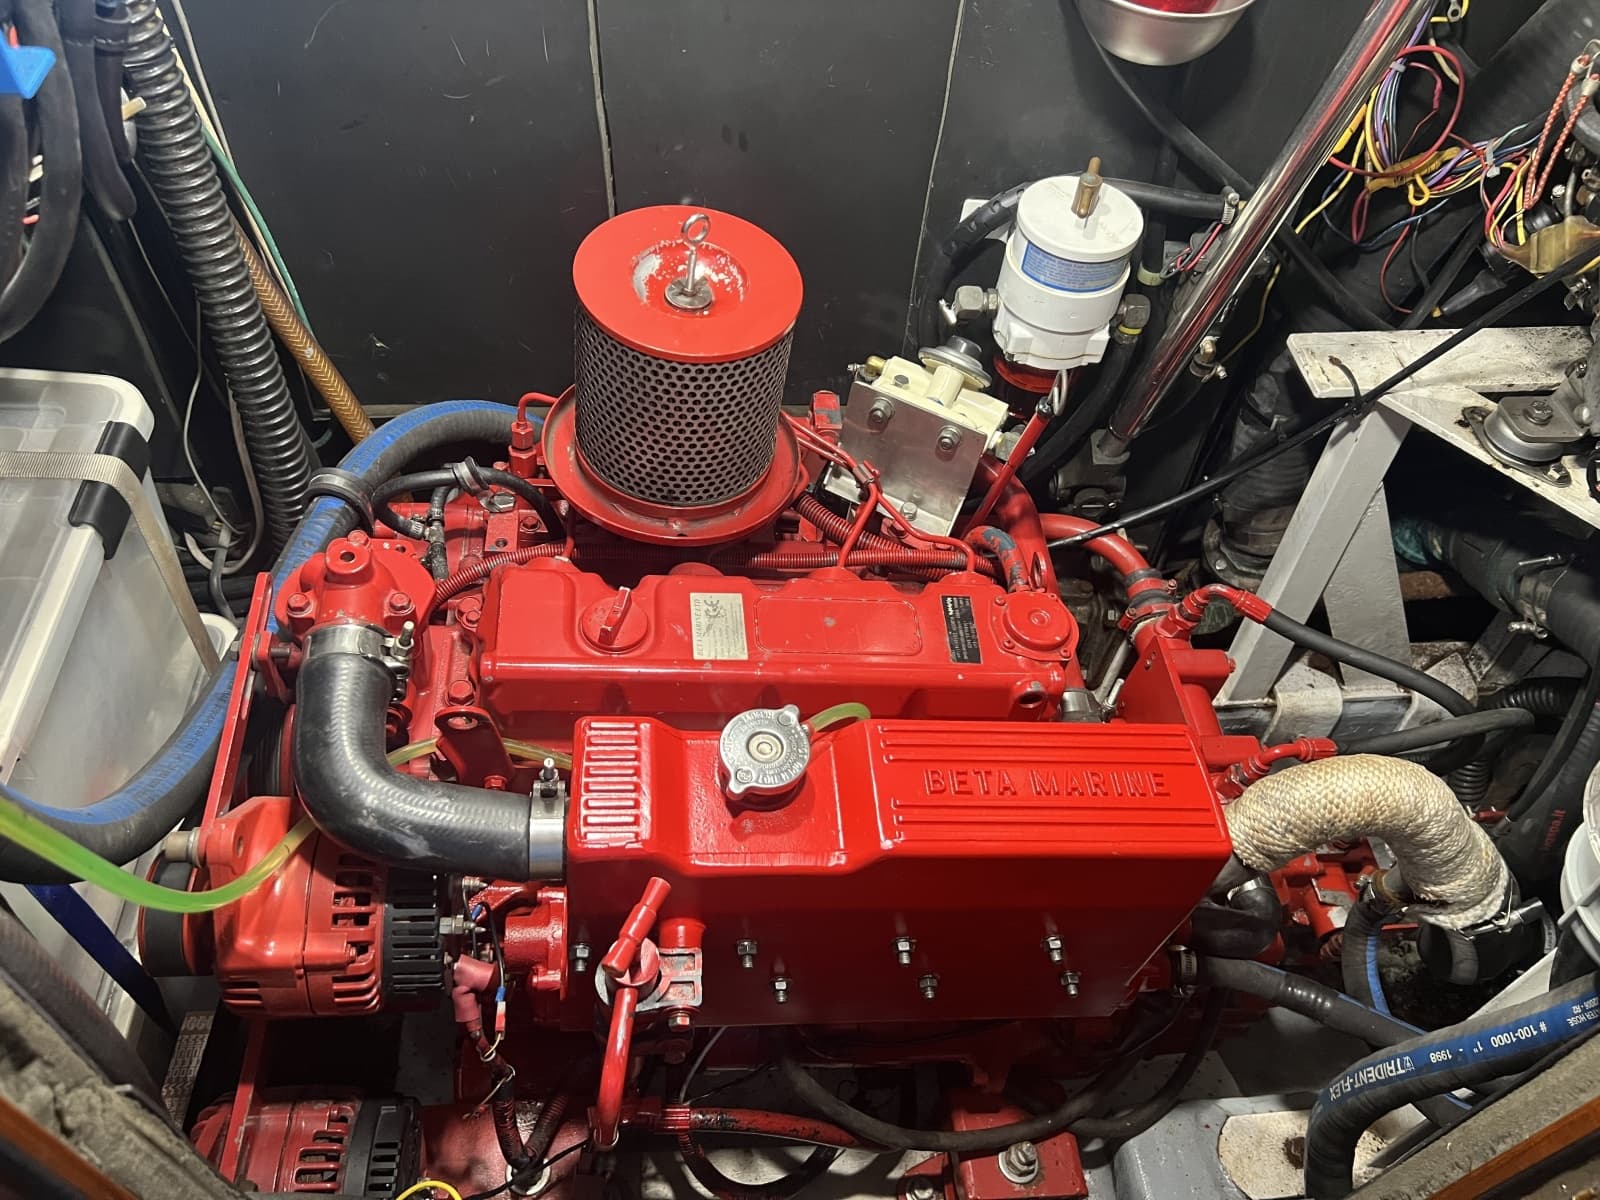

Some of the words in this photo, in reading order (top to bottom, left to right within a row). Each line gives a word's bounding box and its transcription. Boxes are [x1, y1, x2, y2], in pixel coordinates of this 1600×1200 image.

[922, 767, 1018, 796] BETA
[1029, 768, 1172, 798] MARINE
[1538, 1021, 1548, 1033] #
[1566, 1013, 1587, 1027] HOSE
[1490, 1024, 1538, 1048] 100-1000
[1429, 1048, 1453, 1063] 1998
[1329, 1056, 1405, 1101] TRIDENT-FLEX
